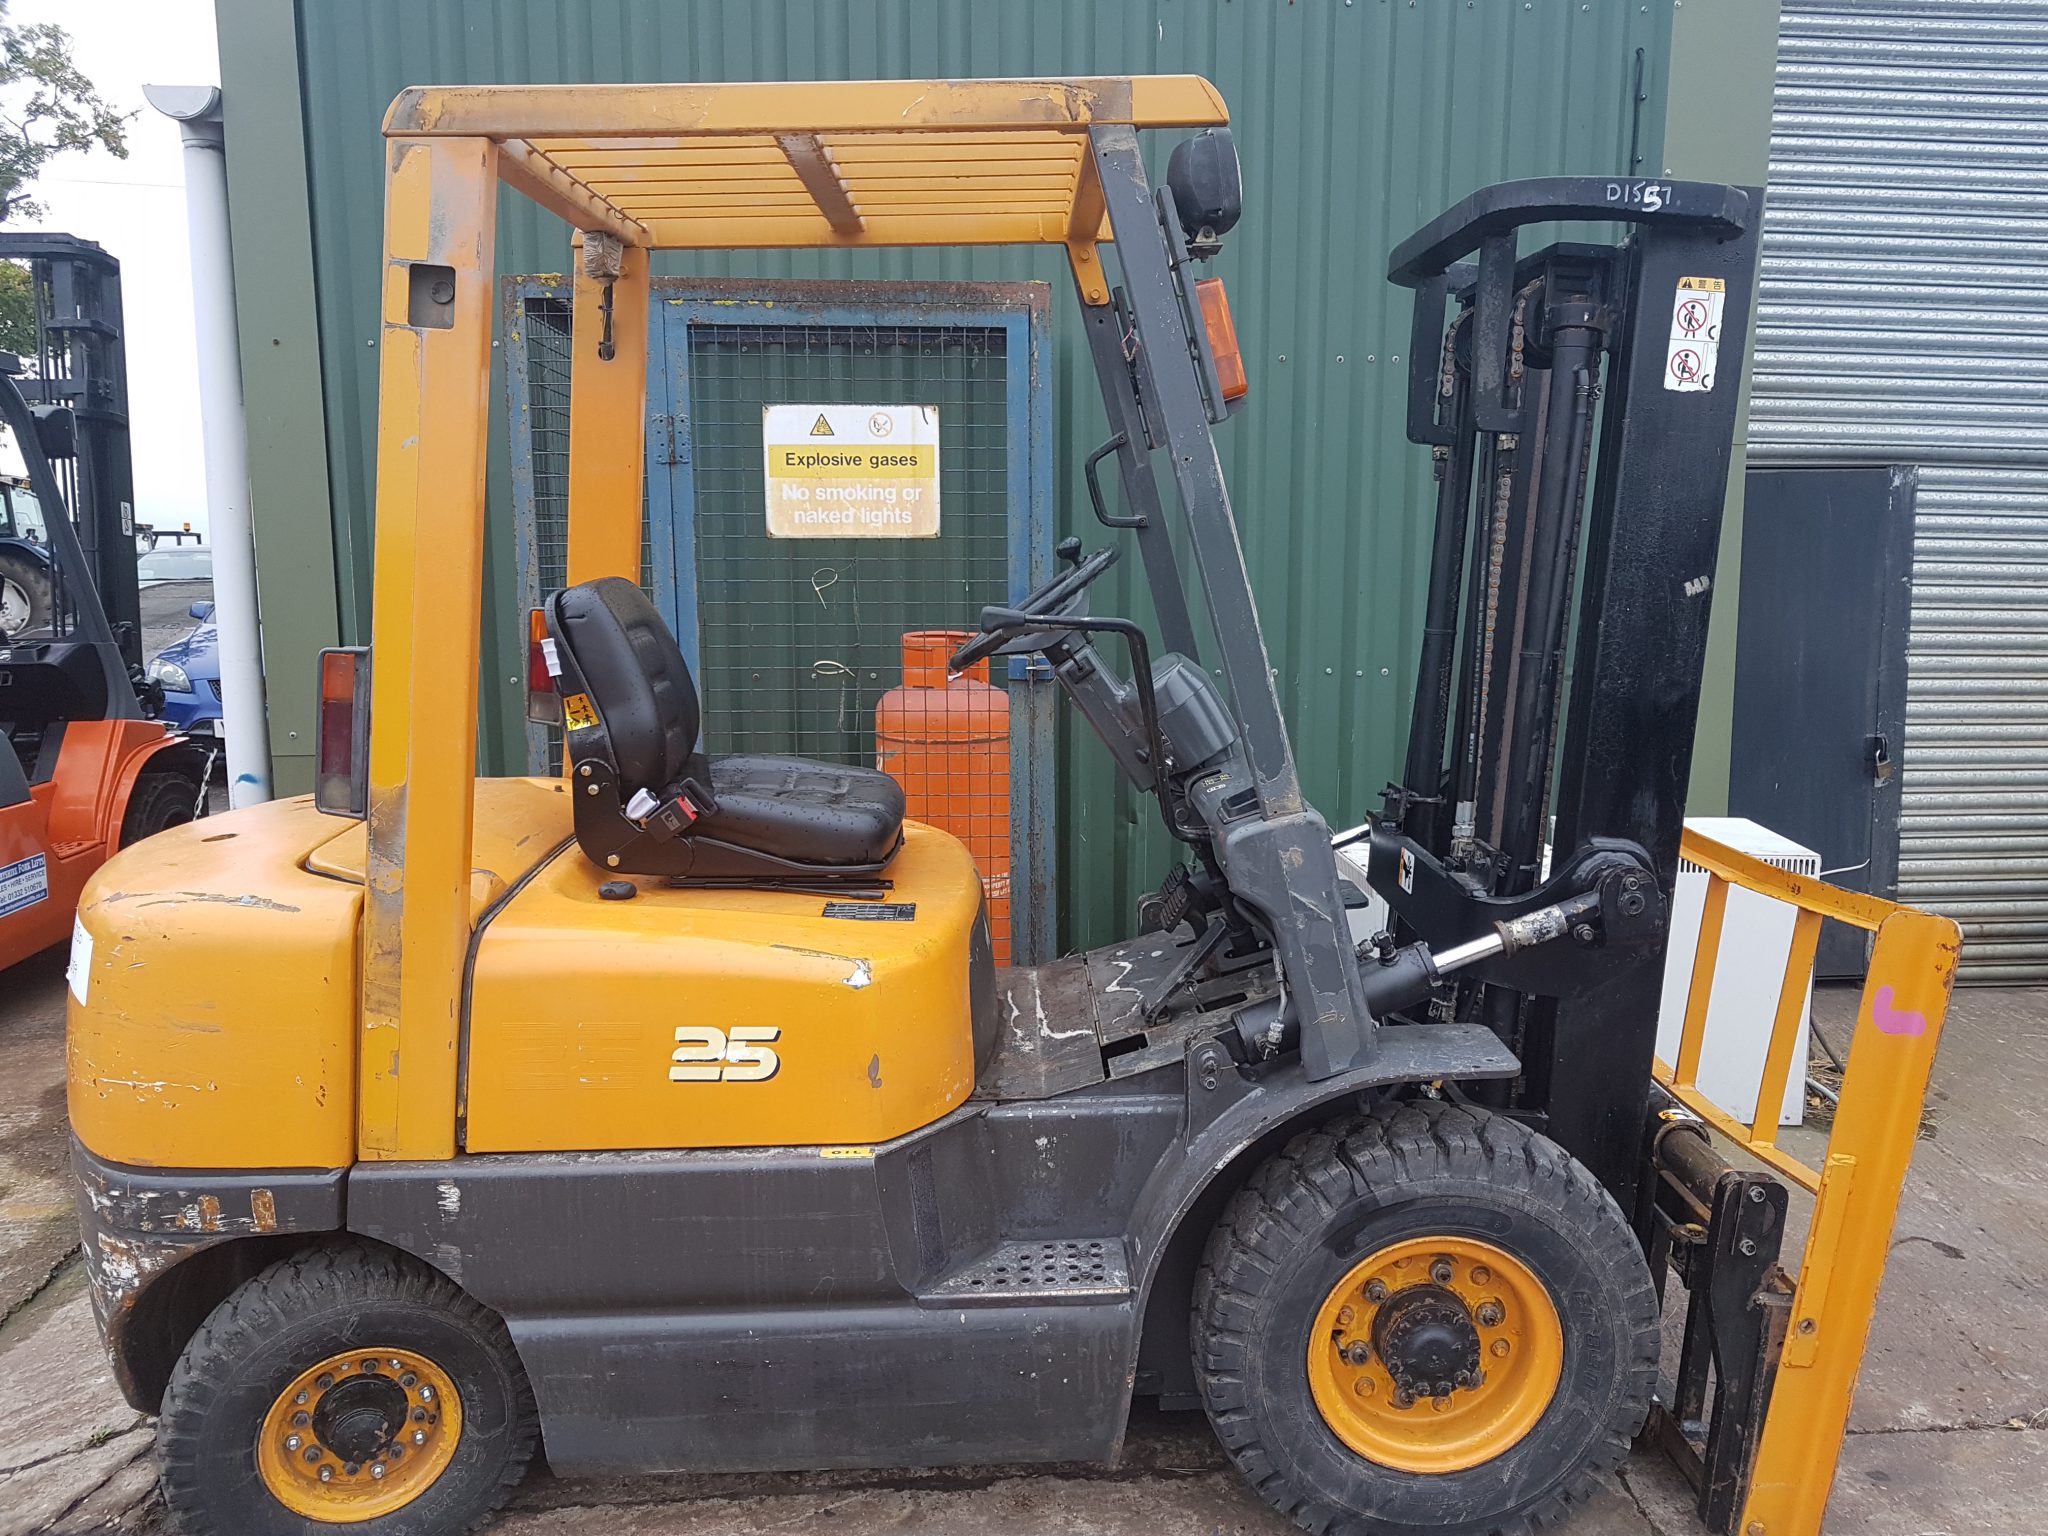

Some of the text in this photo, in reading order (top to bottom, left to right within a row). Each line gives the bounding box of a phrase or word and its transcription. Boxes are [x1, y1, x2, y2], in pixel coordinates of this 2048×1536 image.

[785, 452, 918, 469] Explosive gases
[782, 484, 922, 504] No smoking or
[794, 508, 912, 526] naked lights
[668, 1026, 781, 1082] 25
